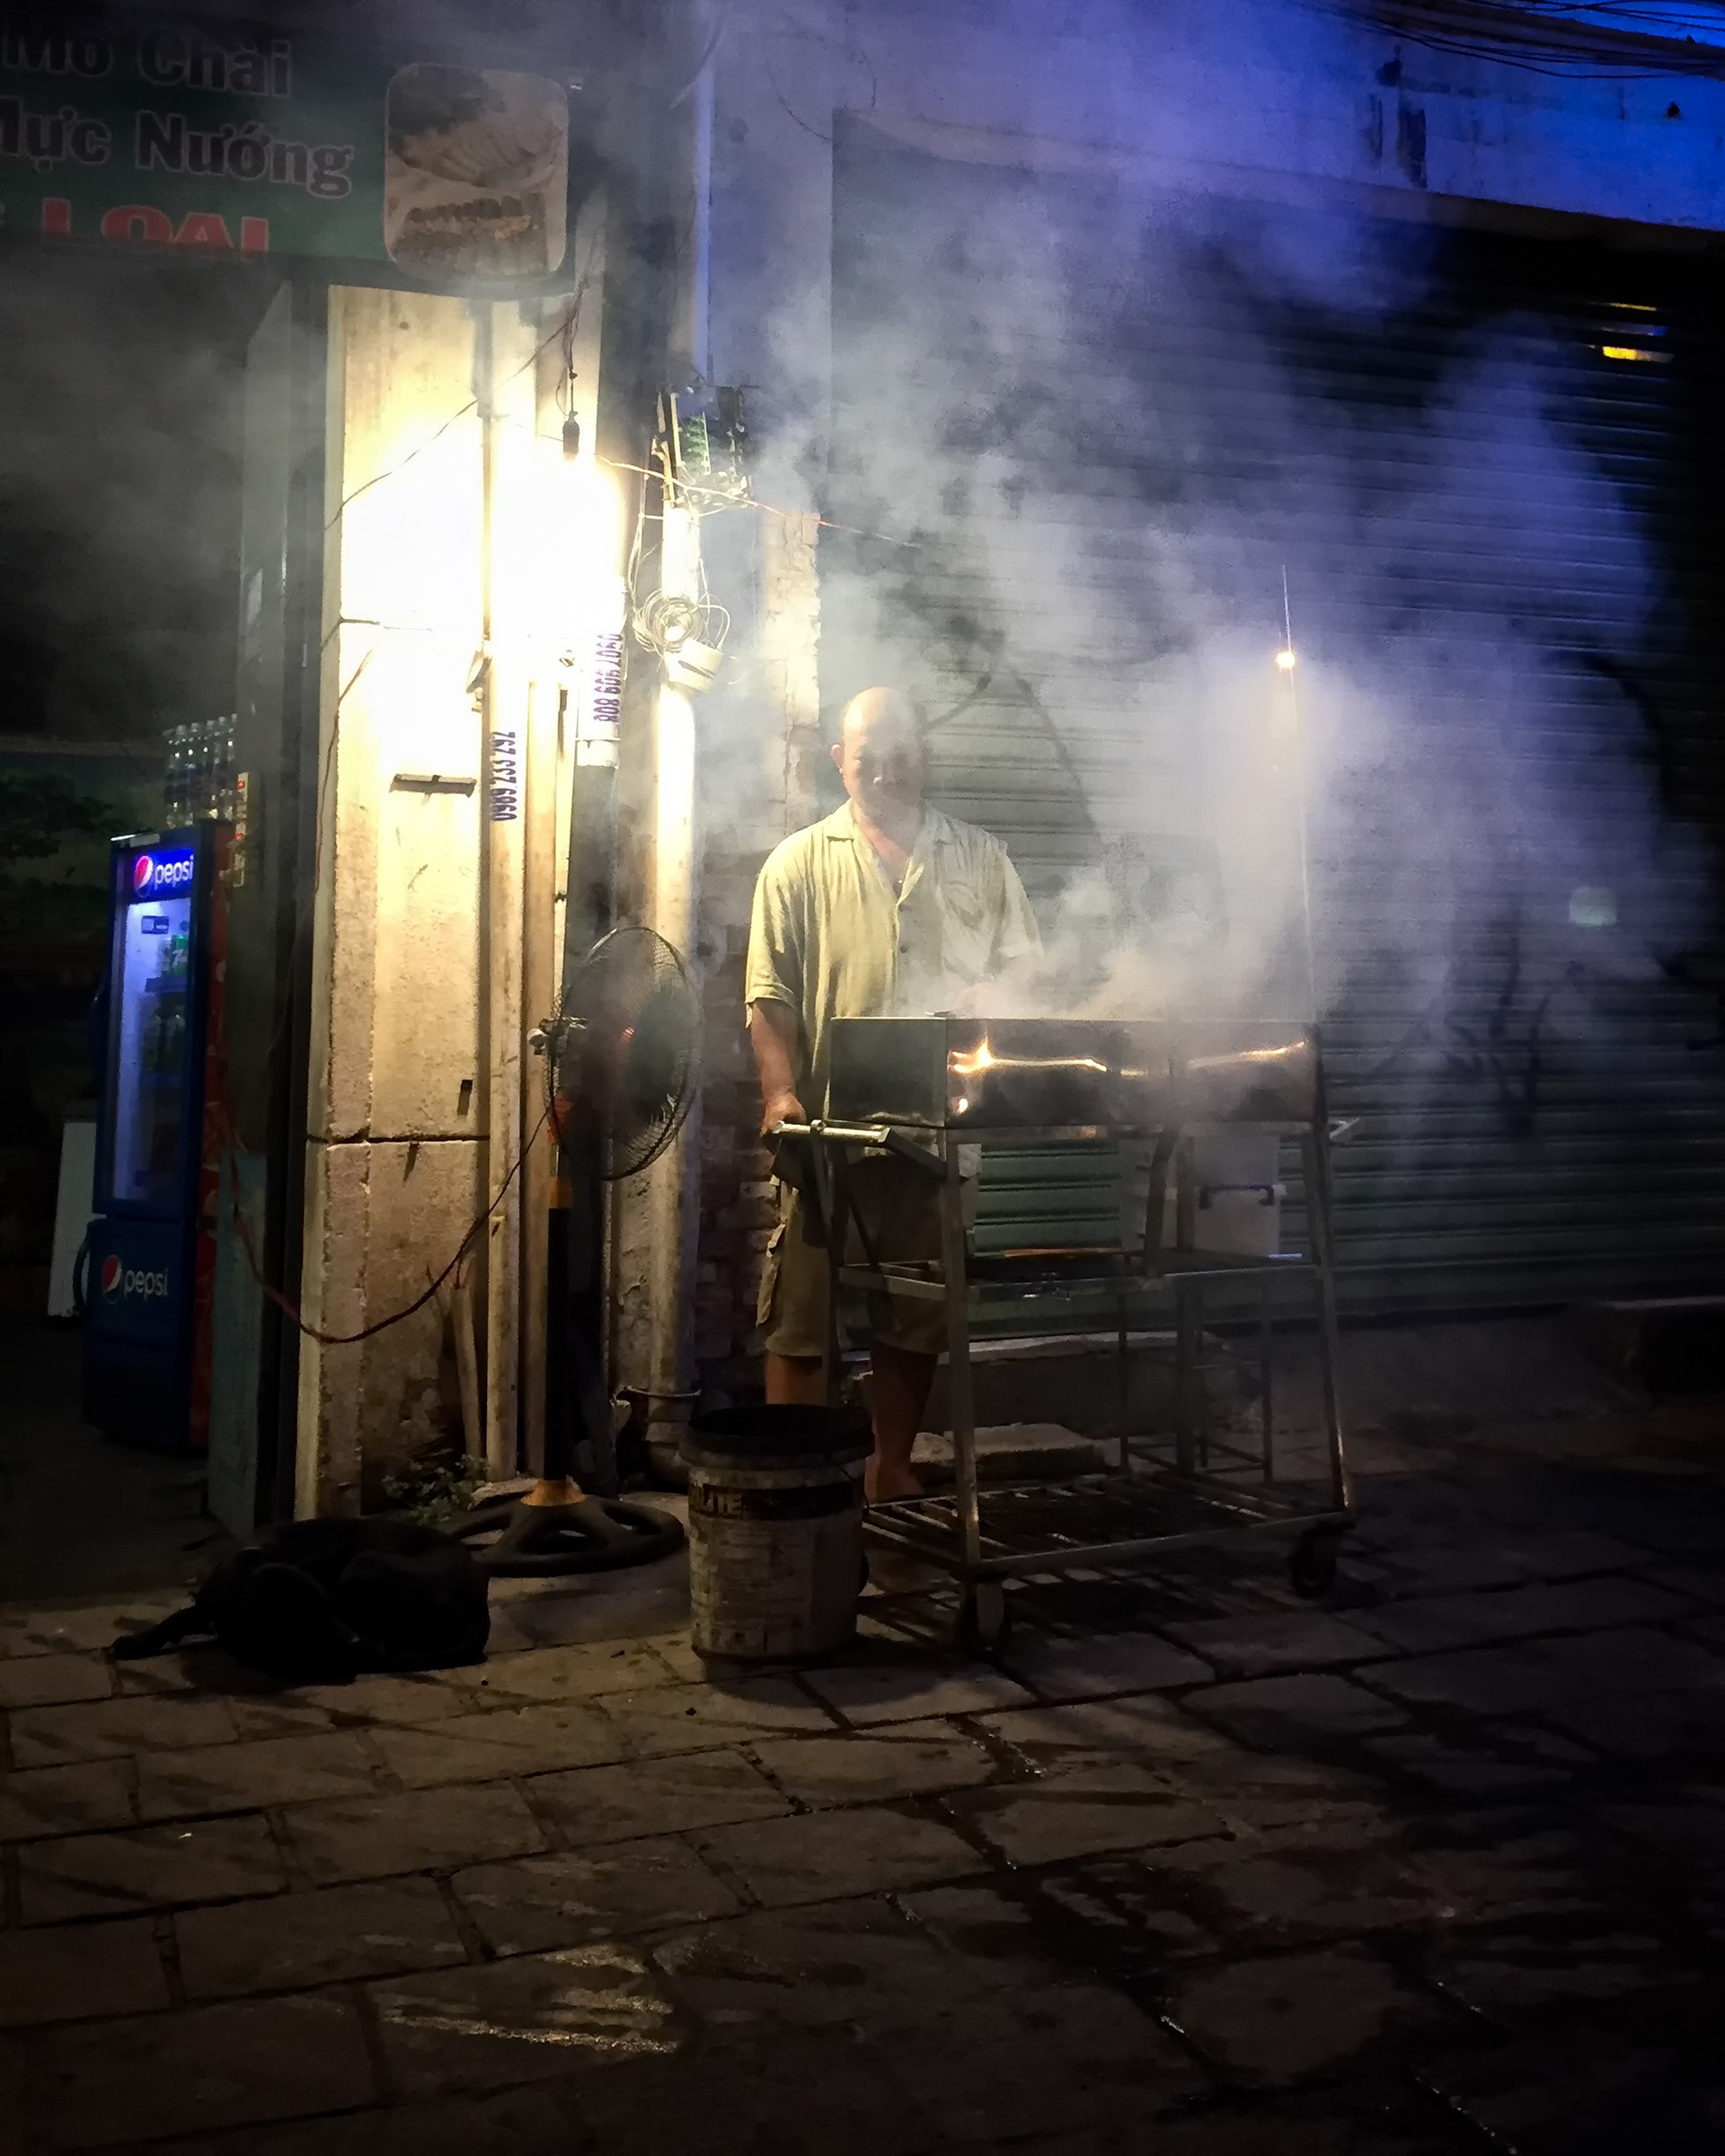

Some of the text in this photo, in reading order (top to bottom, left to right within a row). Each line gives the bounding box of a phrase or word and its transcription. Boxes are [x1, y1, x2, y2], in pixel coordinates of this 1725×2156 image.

[135, 109, 355, 199] Nướng
[155, 854, 194, 891] pepsi
[124, 1267, 169, 1302] pepsi
